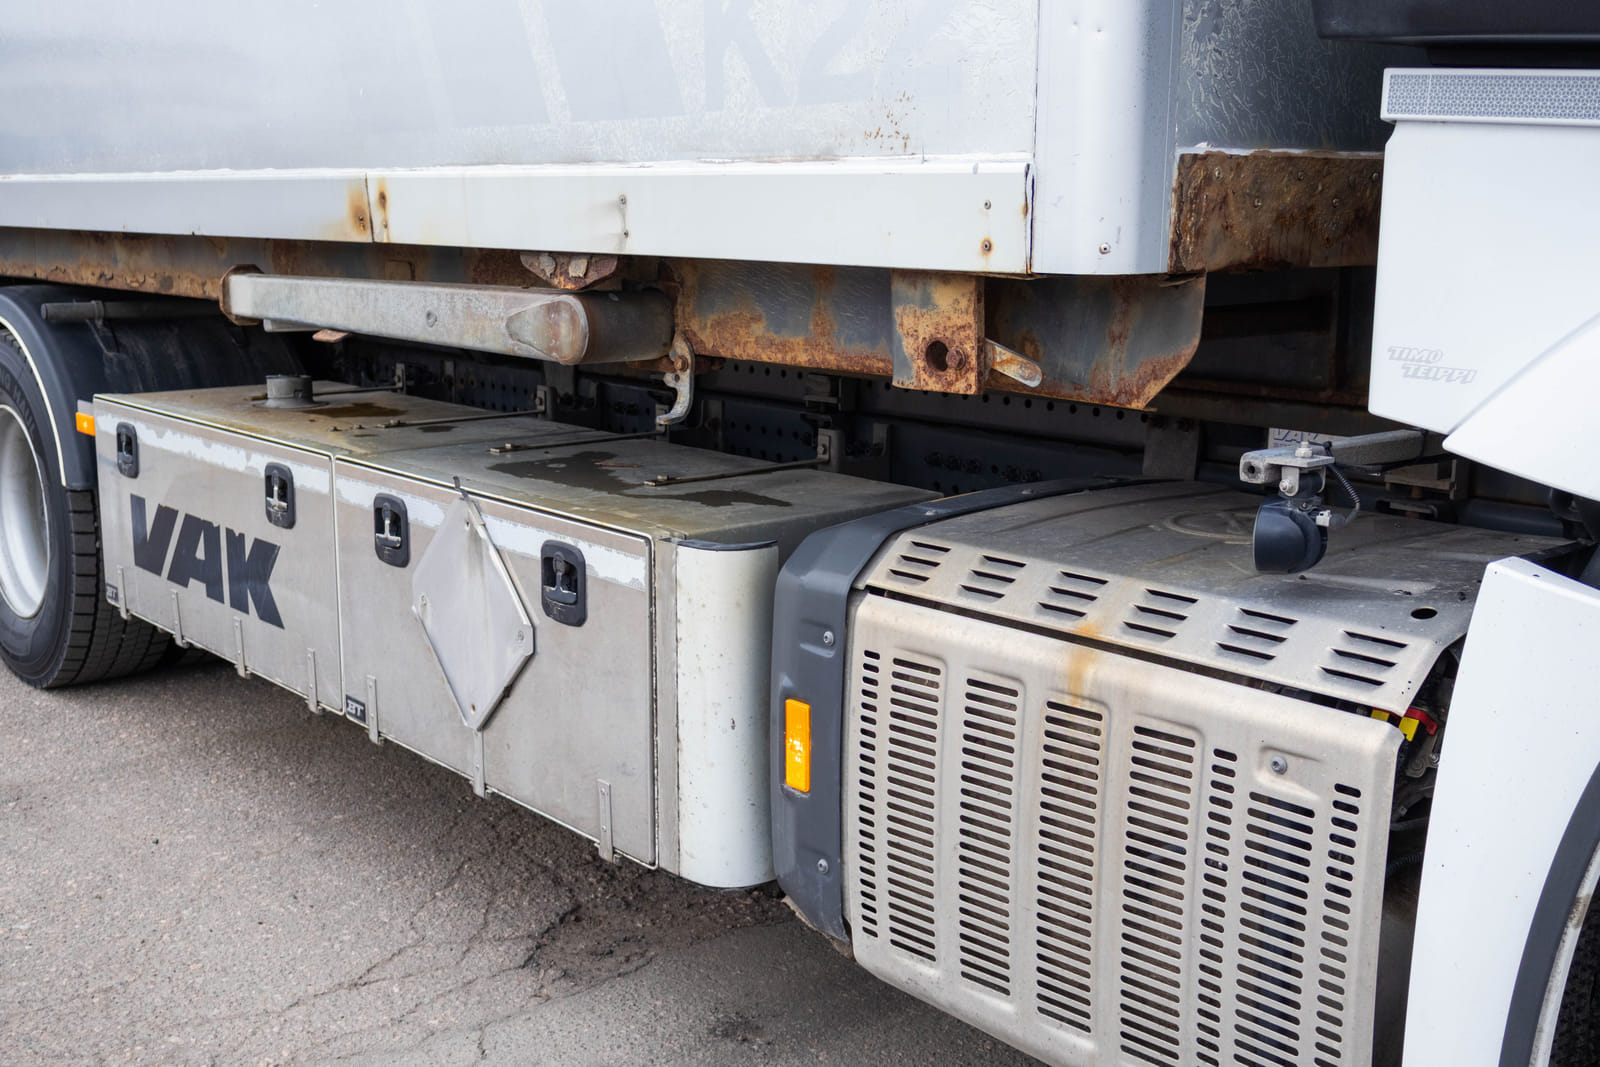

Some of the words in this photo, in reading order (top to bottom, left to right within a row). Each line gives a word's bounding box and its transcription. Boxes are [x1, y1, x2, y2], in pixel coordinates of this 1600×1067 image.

[1388, 346, 1443, 363] TIMO
[1401, 363, 1477, 384] TEIPPI
[130, 494, 285, 630] VAK
[346, 699, 364, 716] BT
